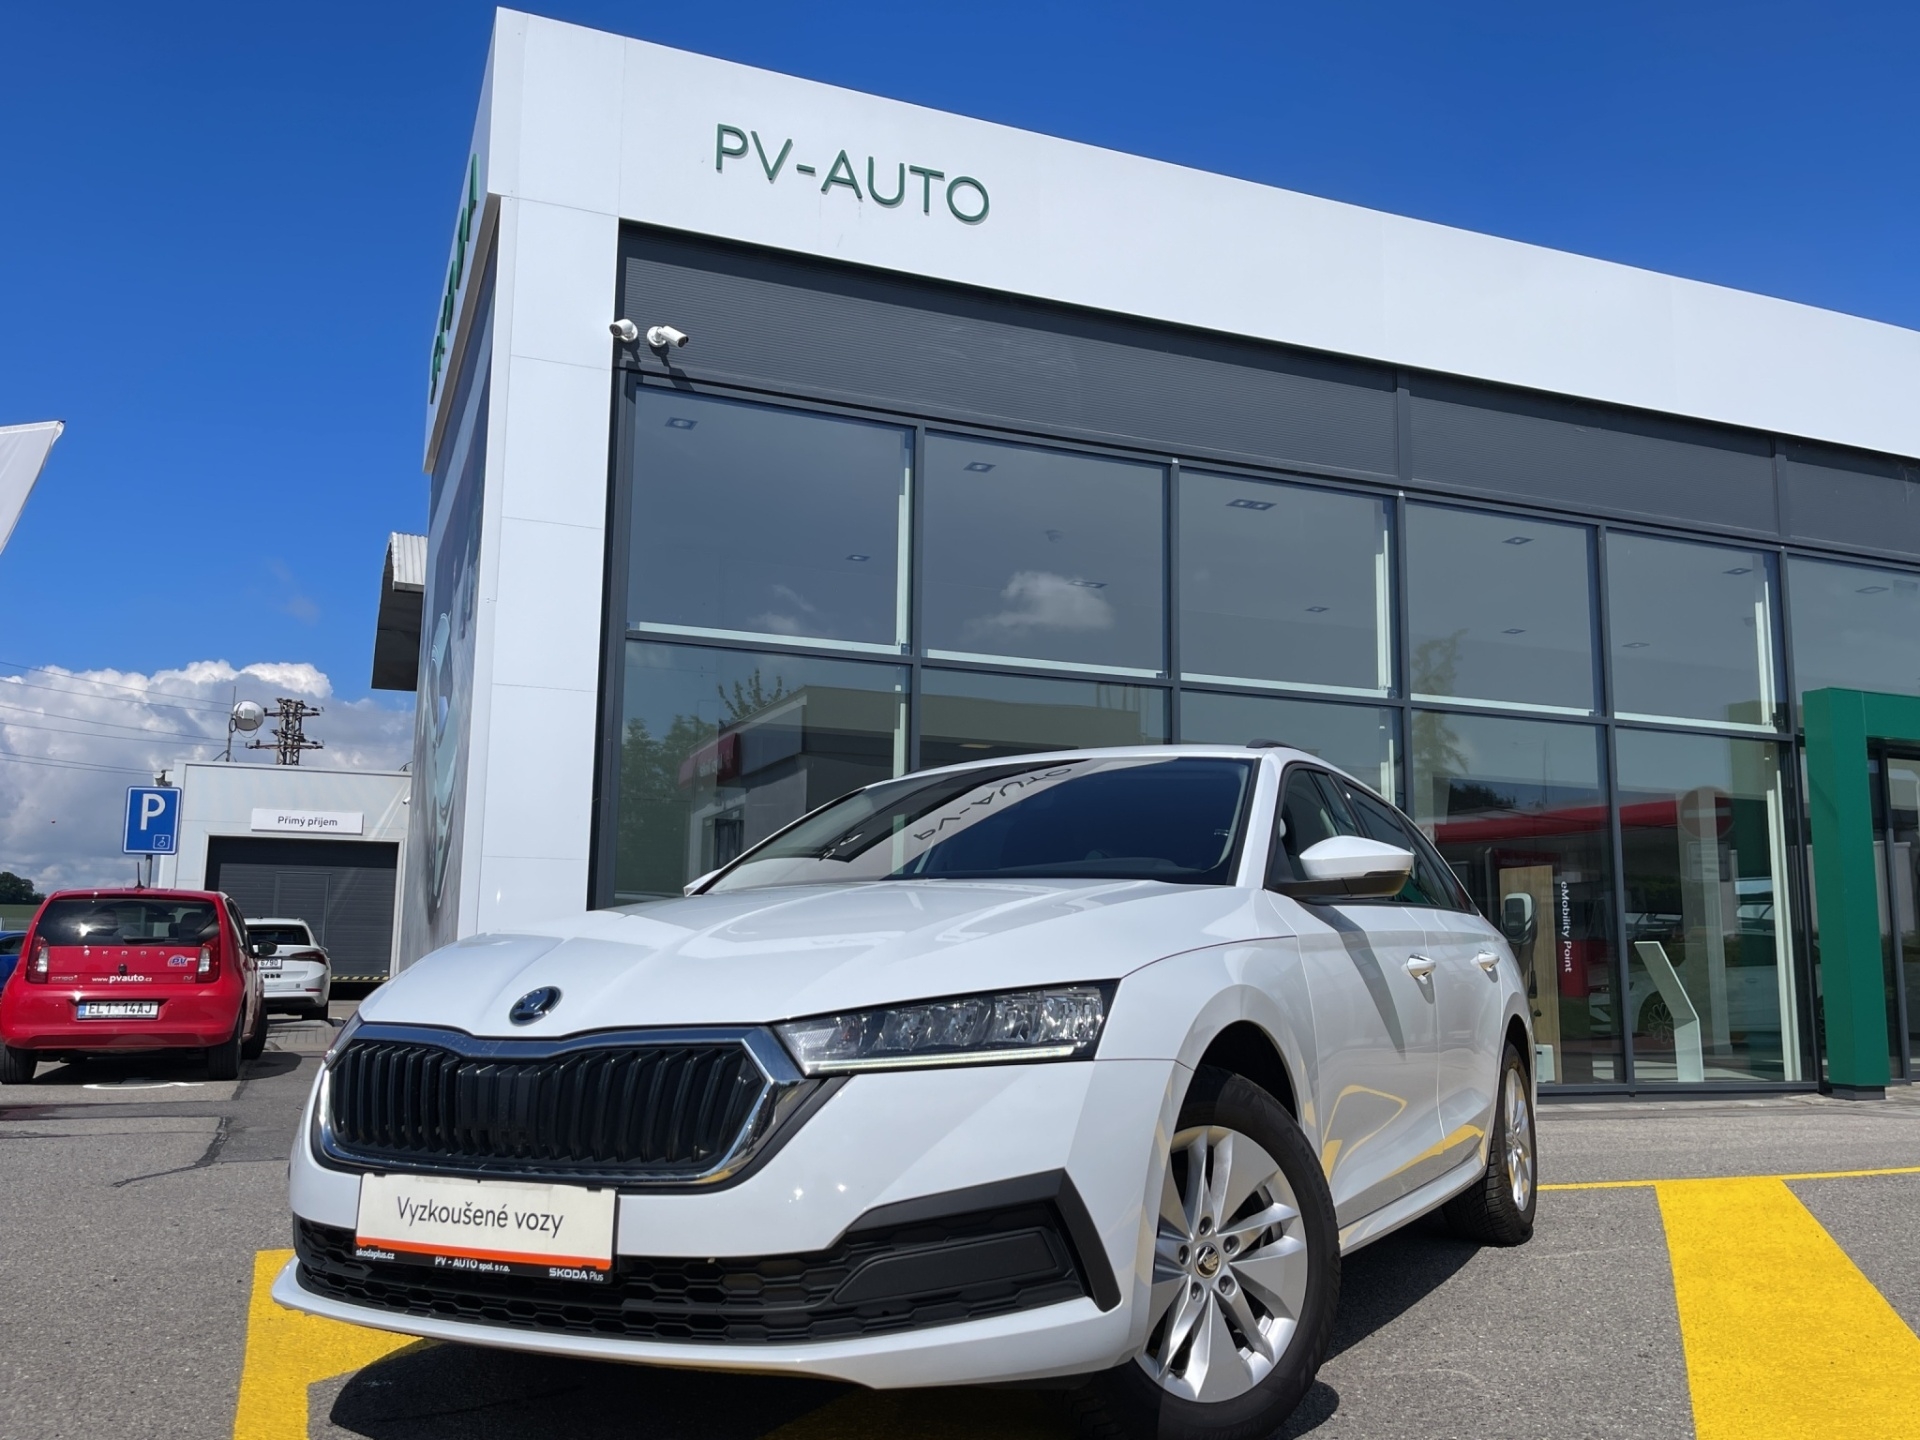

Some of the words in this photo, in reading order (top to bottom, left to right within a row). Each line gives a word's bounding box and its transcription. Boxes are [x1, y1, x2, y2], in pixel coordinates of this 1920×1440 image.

[715, 122, 990, 224] PV-AUTO
[140, 793, 166, 831] P
[277, 815, 305, 827] Přímý
[1560, 881, 1571, 938] eMobility
[1563, 941, 1572, 973] Point
[92, 974, 152, 984] www.pvauto.cz
[88, 1002, 112, 1014] EL1
[122, 1002, 153, 1014] 14AJ
[397, 1195, 509, 1228] Vyzkoušené
[514, 1211, 564, 1239] vozy
[355, 1248, 395, 1261] skodaplus.cz
[434, 1255, 447, 1266] PV
[453, 1258, 478, 1270] AUTO
[478, 1261, 494, 1272] spol.
[589, 1271, 604, 1282] Plus
